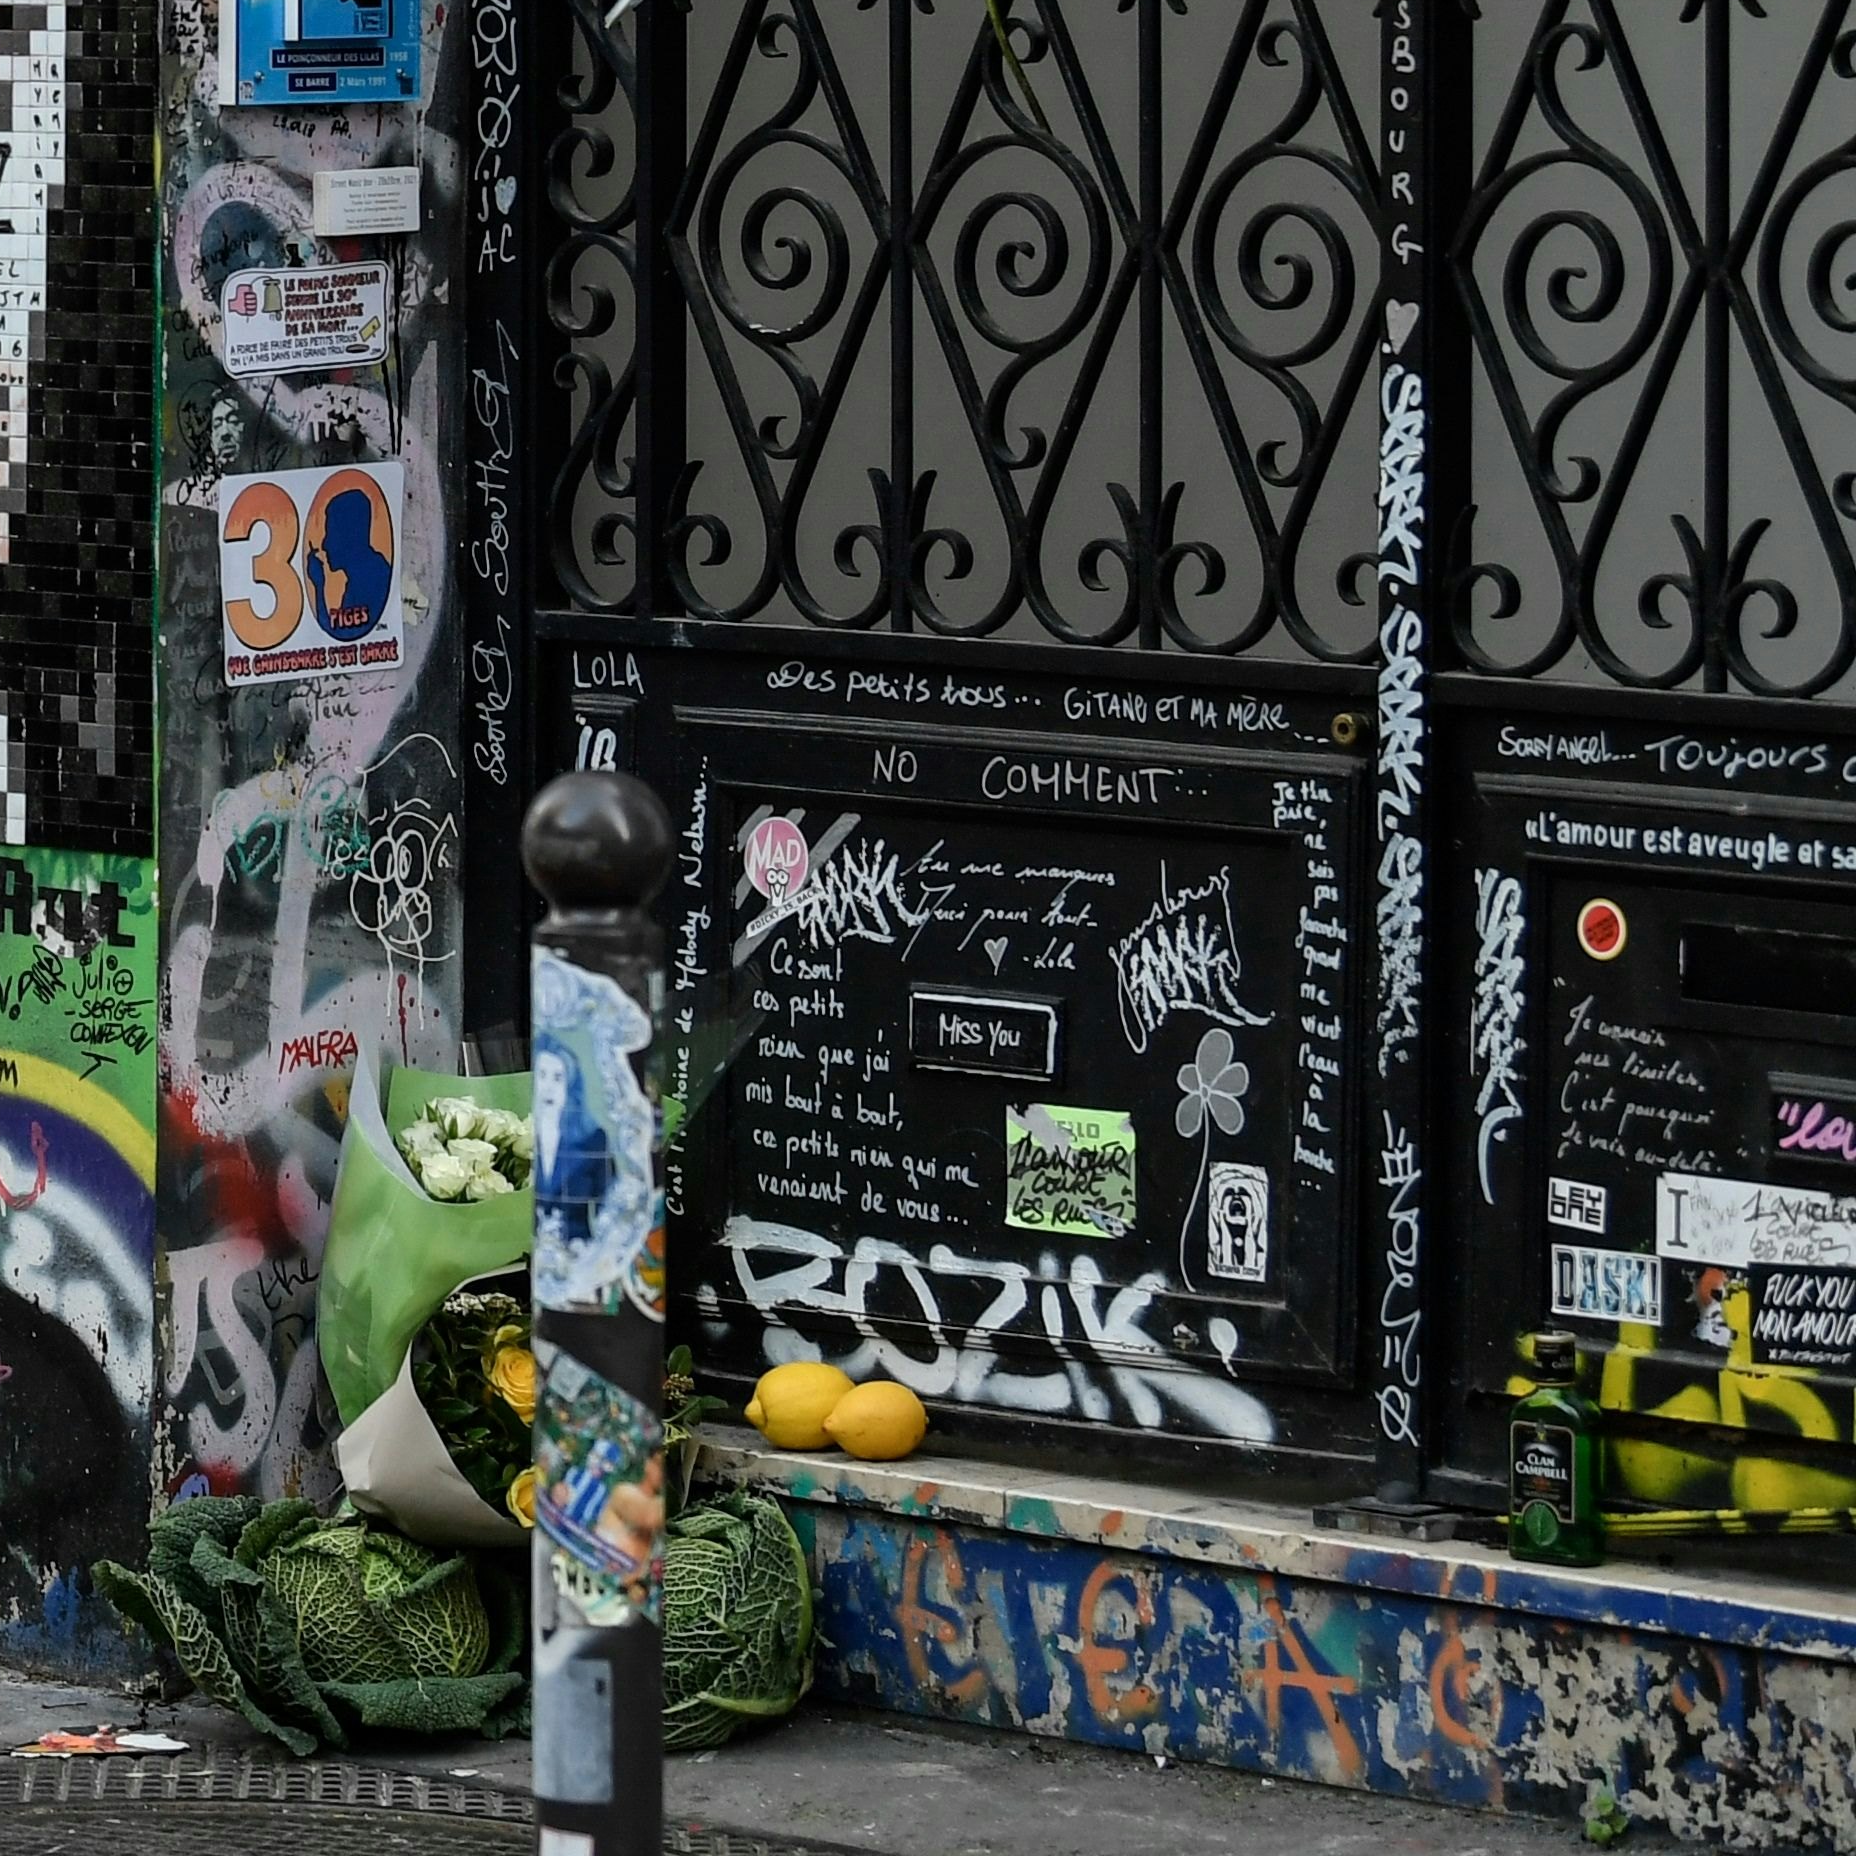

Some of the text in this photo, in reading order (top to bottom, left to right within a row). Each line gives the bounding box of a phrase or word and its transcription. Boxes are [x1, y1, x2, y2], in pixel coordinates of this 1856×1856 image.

[328, 606, 370, 629] PIGES
[227, 657, 252, 679] QUE
[572, 651, 645, 696] LOLA
[767, 659, 933, 710] Des petits
[1190, 698, 1222, 730] MA
[872, 747, 919, 785] NO
[751, 835, 803, 868] MAD
[1643, 821, 1684, 856] est
[1688, 827, 1789, 870] aveugle
[1796, 834, 1824, 868] et
[769, 937, 844, 983] Ce sont
[752, 987, 845, 1029] ces petits
[1301, 984, 1330, 1007] me
[938, 1013, 1022, 1056] Miss You
[757, 1033, 857, 1086] rien que
[745, 1076, 774, 1106] mis
[784, 1074, 823, 1116] bout
[830, 1093, 845, 1121] à
[1301, 1101, 1330, 1133] la
[752, 1127, 980, 1192] ces petits rien qui me
[757, 1170, 888, 1215] venaient de
[1552, 1181, 1604, 1208] LEY
[1764, 1272, 1856, 1312] FUCK YOU
[1753, 1309, 1790, 1341] MON
[1515, 1460, 1569, 1481] CAMPBELL
[1527, 1451, 1556, 1469] CLAN
